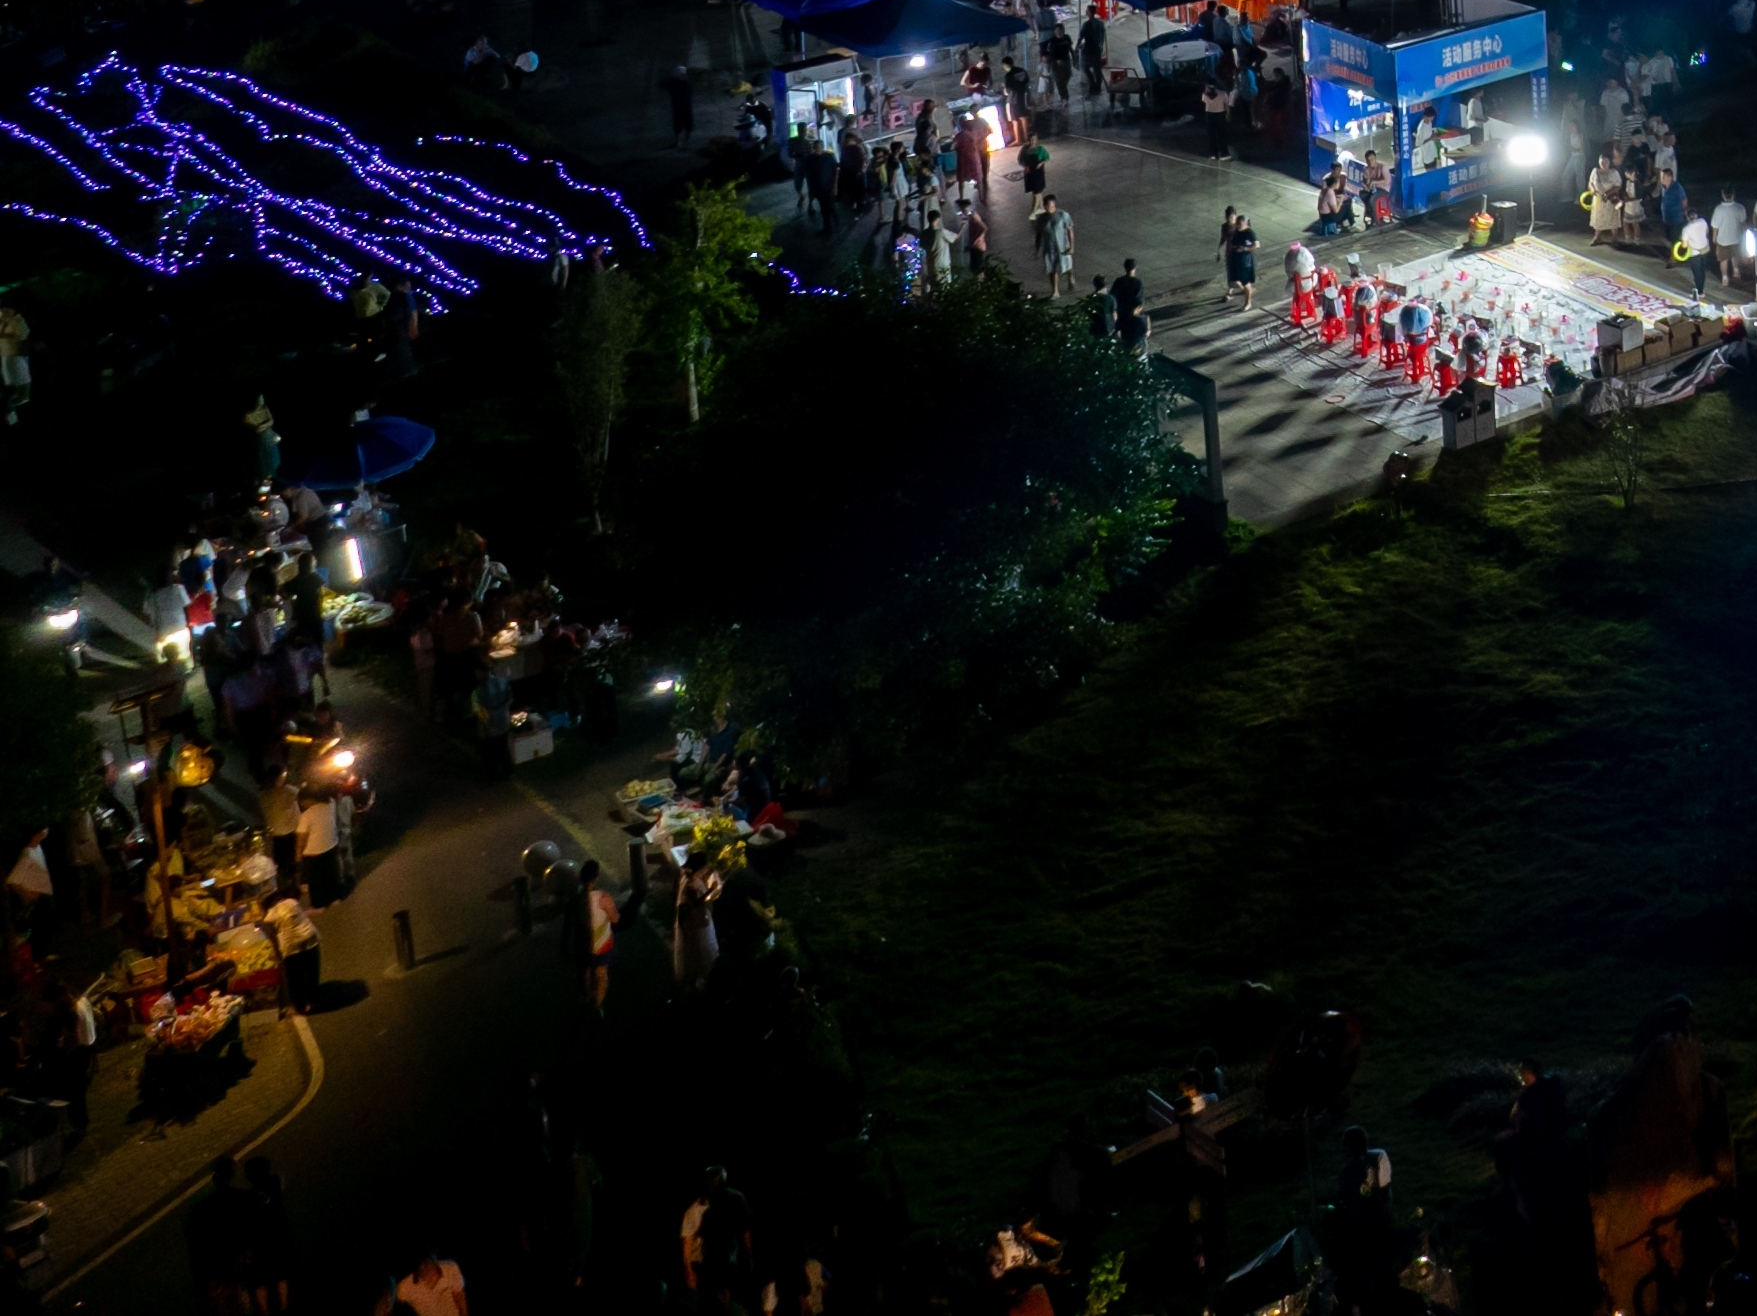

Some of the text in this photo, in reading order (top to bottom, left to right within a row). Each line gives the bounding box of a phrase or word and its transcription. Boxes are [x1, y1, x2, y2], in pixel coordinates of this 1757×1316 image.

[1330, 38, 1369, 70] 活动服务中心
[1442, 34, 1503, 68] 活动服务中心
